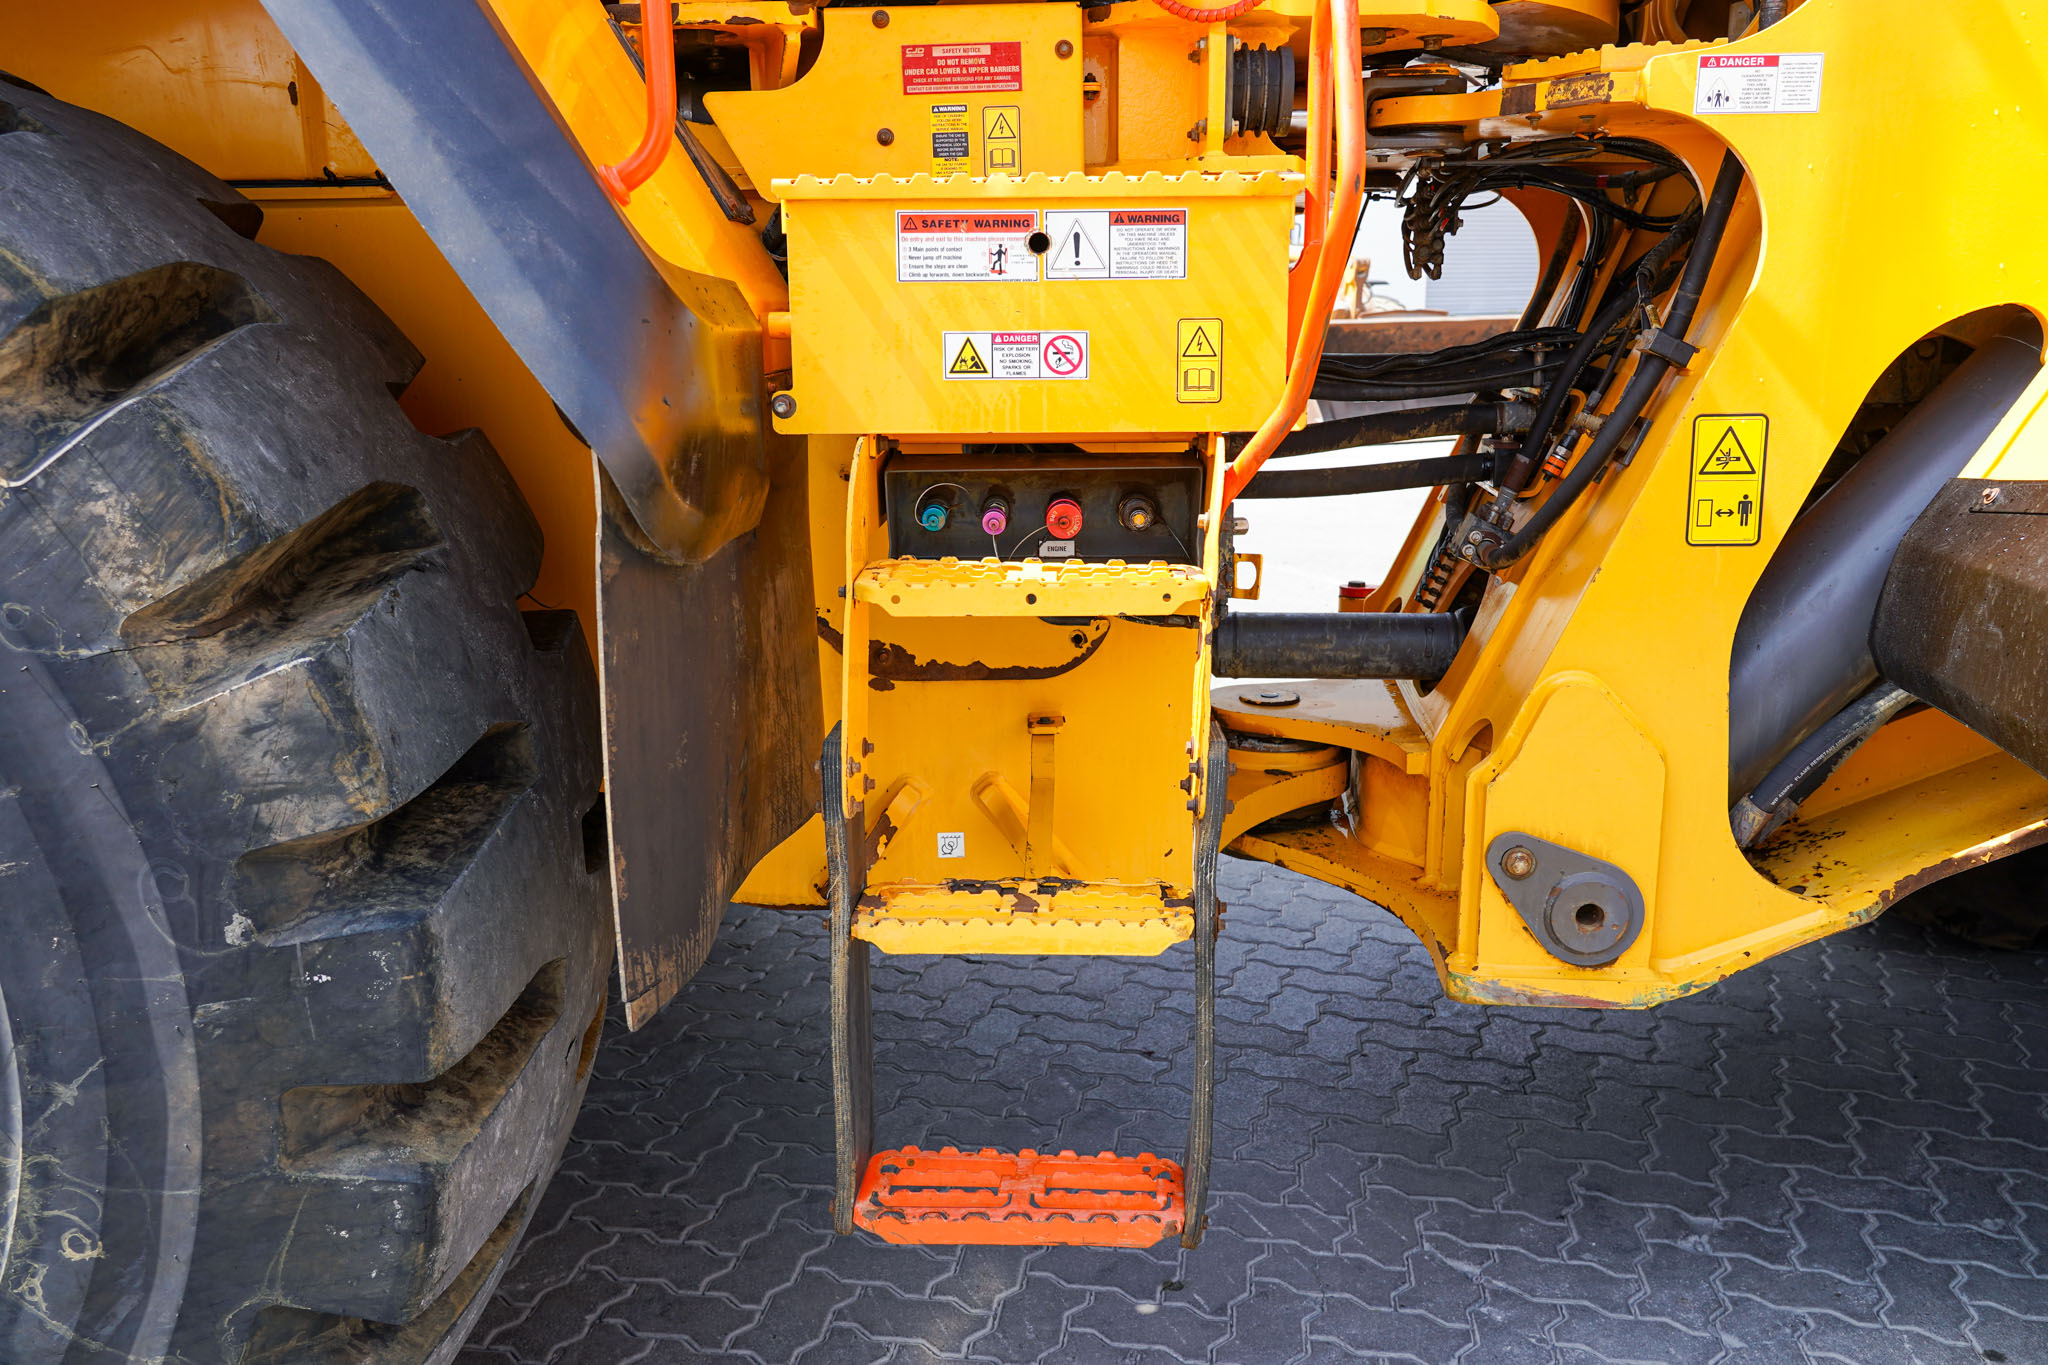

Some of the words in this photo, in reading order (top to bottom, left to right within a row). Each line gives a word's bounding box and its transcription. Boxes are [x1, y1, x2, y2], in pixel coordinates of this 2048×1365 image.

[1720, 57, 1765, 66] DANGER
[990, 65, 1020, 73] BARRIERS
[922, 219, 968, 228] SAFETY
[974, 219, 1030, 228] WARNING
[1127, 215, 1180, 223] WARNING
[1794, 766, 1811, 781] FLAME
[1810, 745, 1836, 767] RESISTANT
